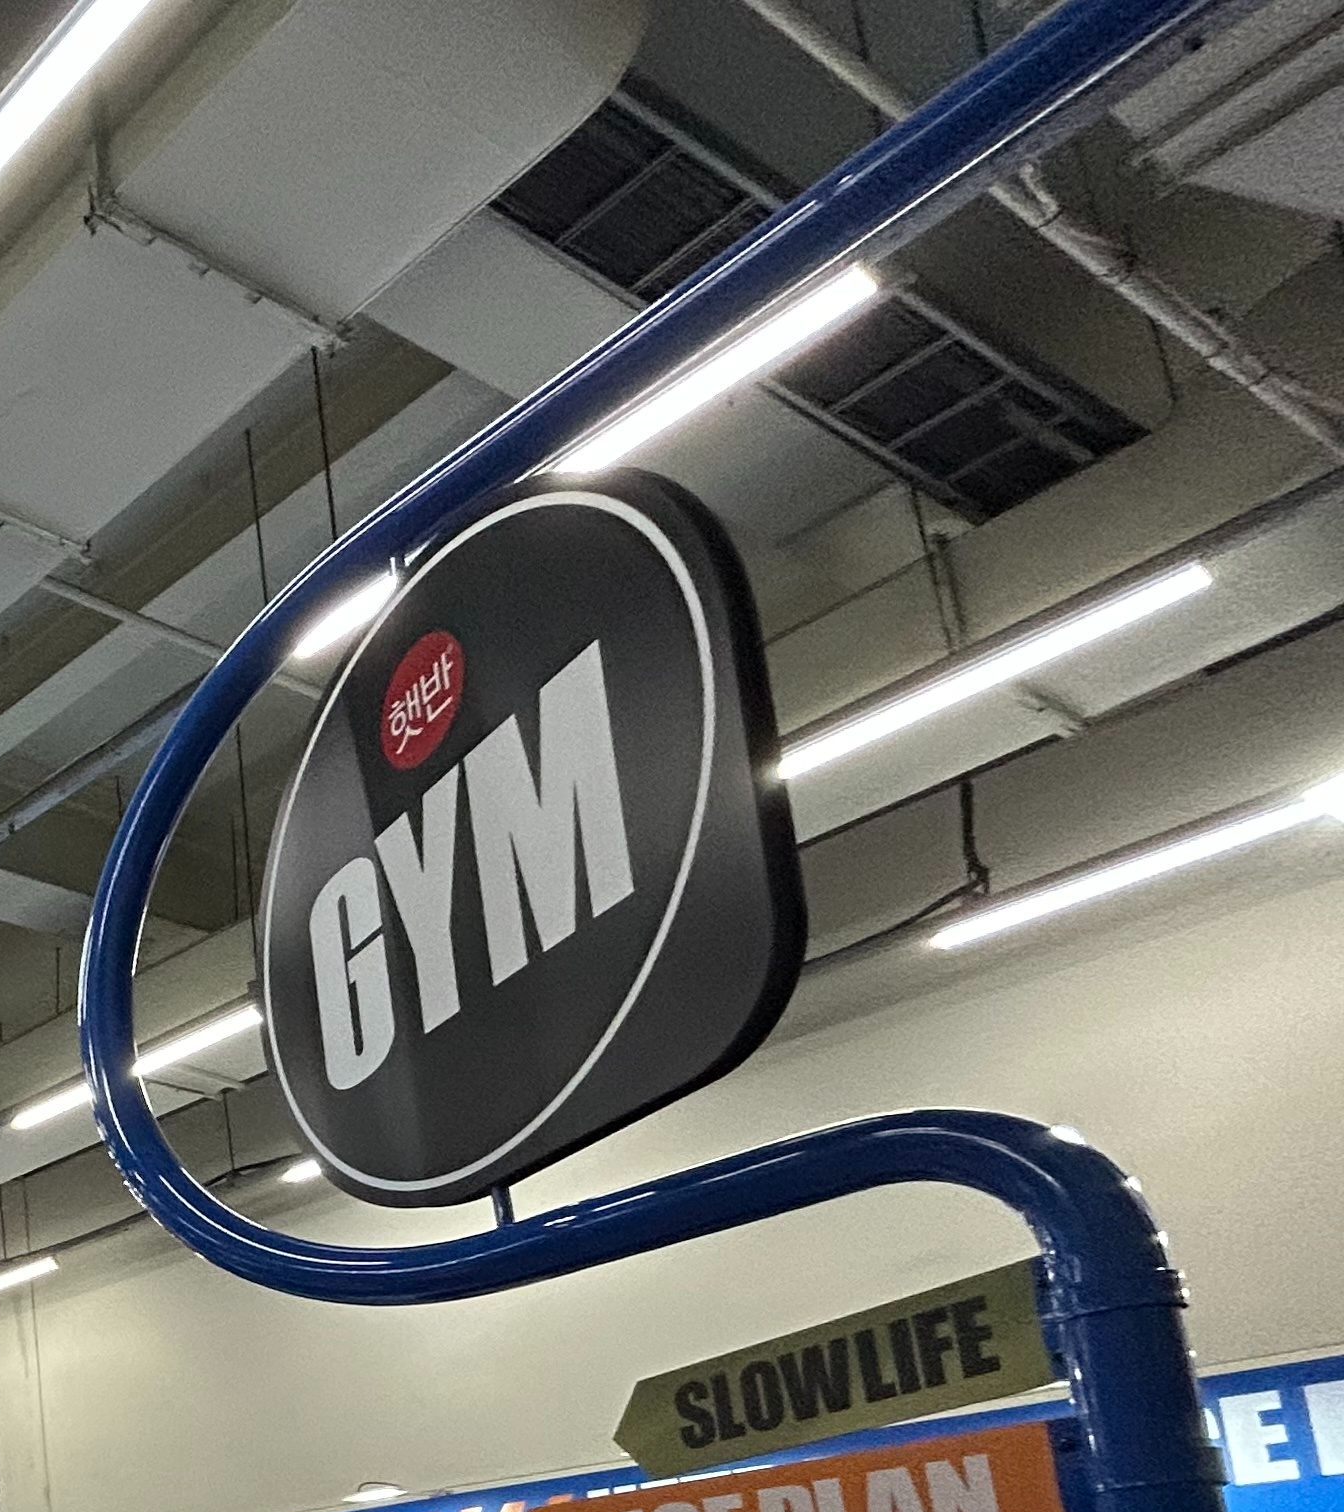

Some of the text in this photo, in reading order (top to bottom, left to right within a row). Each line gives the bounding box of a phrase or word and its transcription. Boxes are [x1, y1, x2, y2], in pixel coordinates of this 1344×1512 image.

[389, 641, 455, 754] 햇반
[309, 638, 635, 1091] GYM
[675, 1295, 1002, 1449] SLOW LIFE
